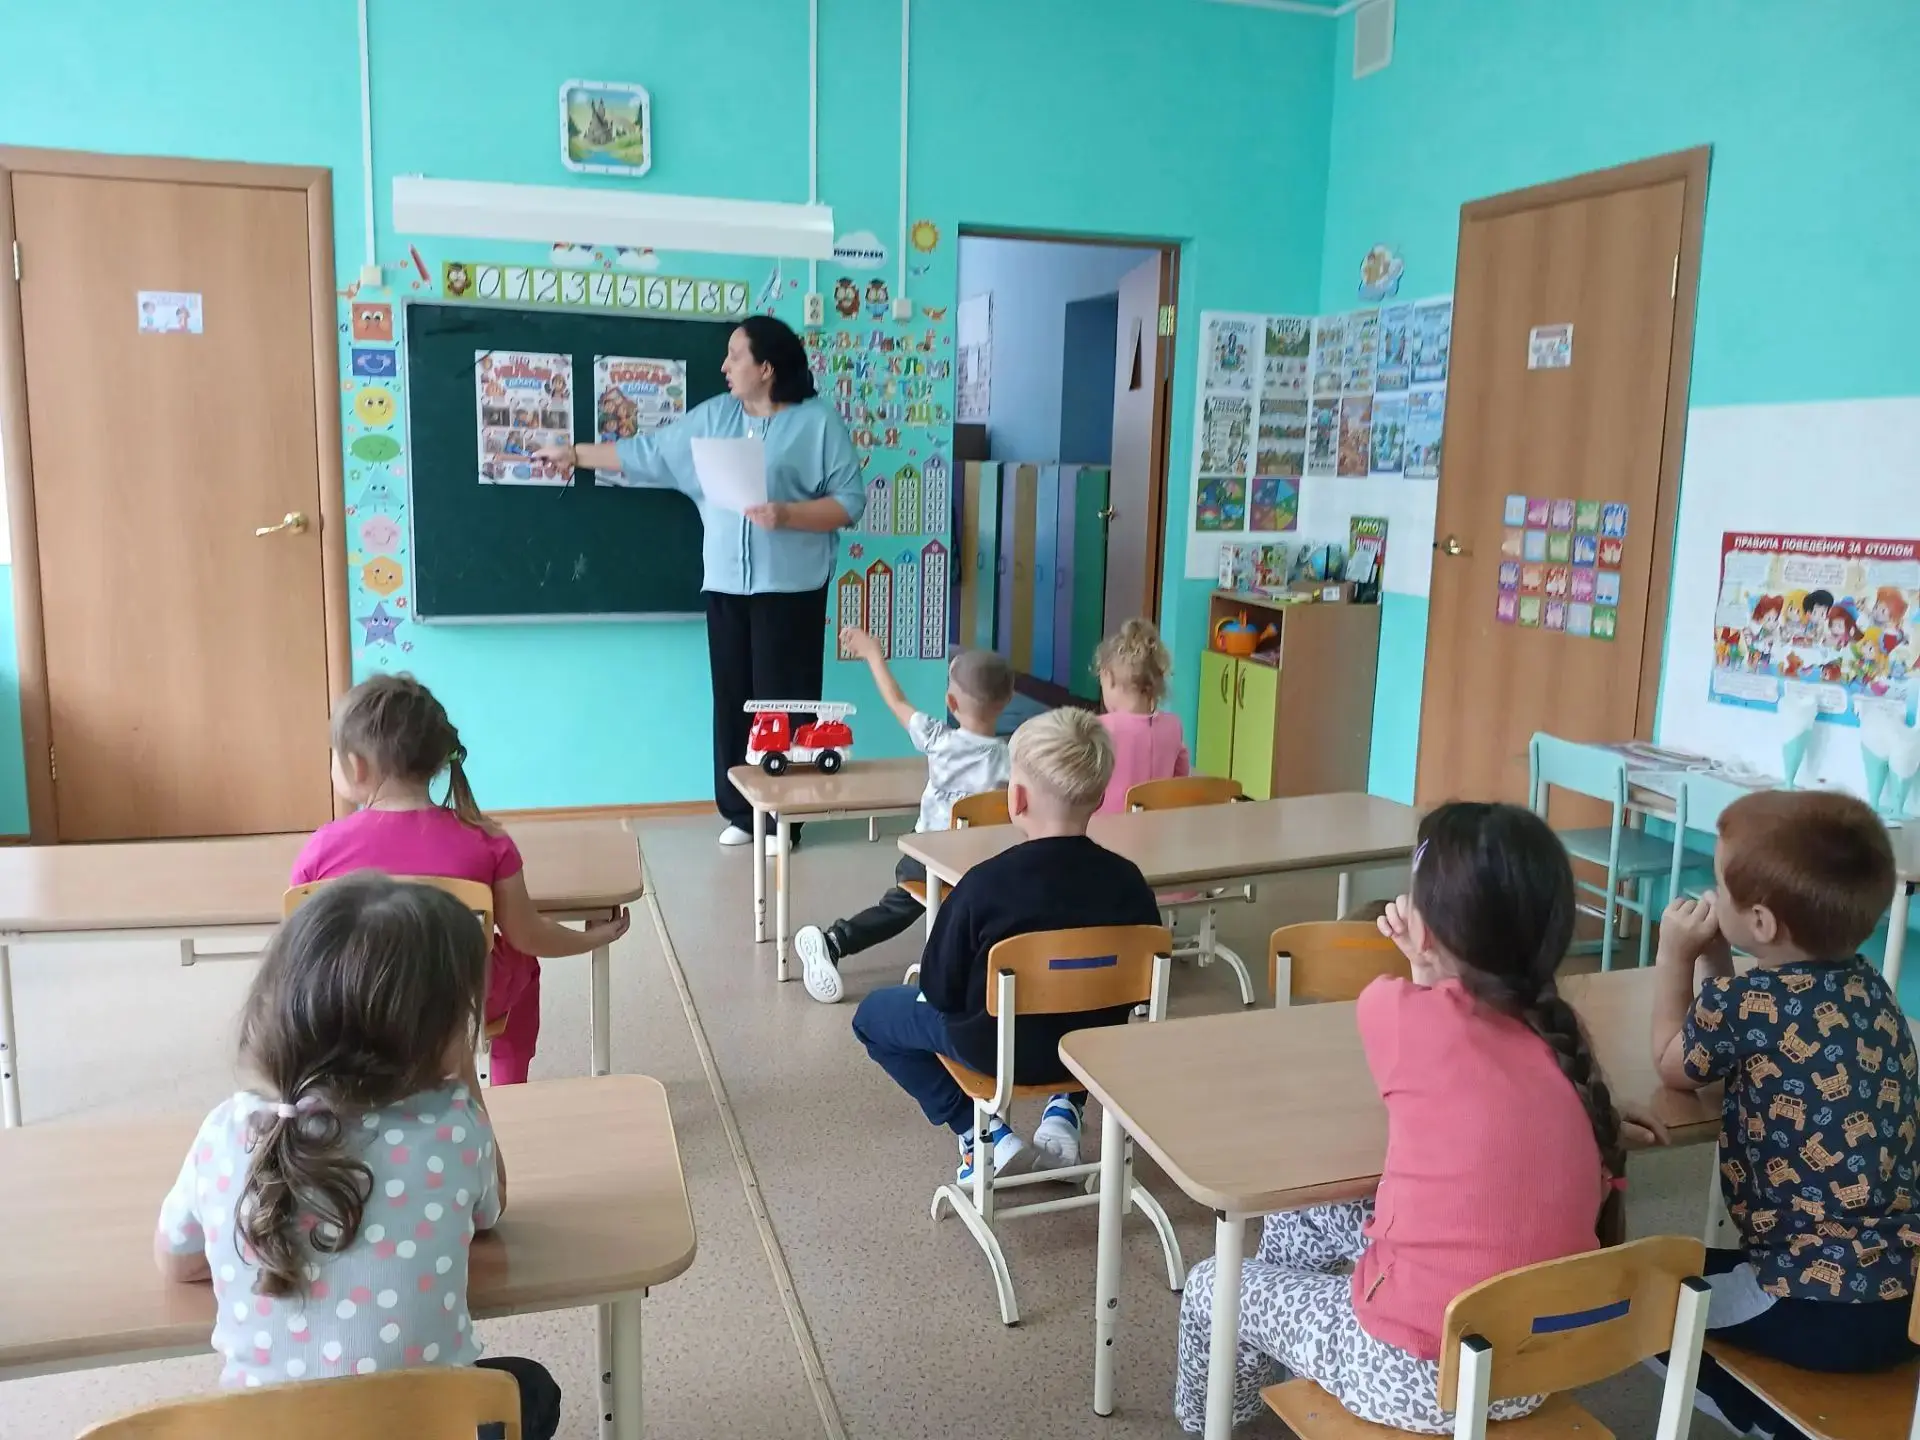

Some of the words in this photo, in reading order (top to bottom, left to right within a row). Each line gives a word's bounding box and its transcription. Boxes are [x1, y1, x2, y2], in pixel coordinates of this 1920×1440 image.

[477, 266, 501, 299] 0
[515, 267, 529, 298] 1
[537, 268, 558, 301] 2
[564, 272, 586, 304] 3
[590, 271, 613, 307] 4
[617, 274, 638, 308] 5
[647, 275, 667, 309] 6
[675, 279, 693, 311] 7
[700, 282, 721, 313] 8
[725, 282, 747, 314] 9
[1734, 536, 1779, 550] ПРАВИЛА
[1781, 538, 1846, 554] ПОВЕДЕНИЯ
[1847, 541, 1862, 554] ЗА
